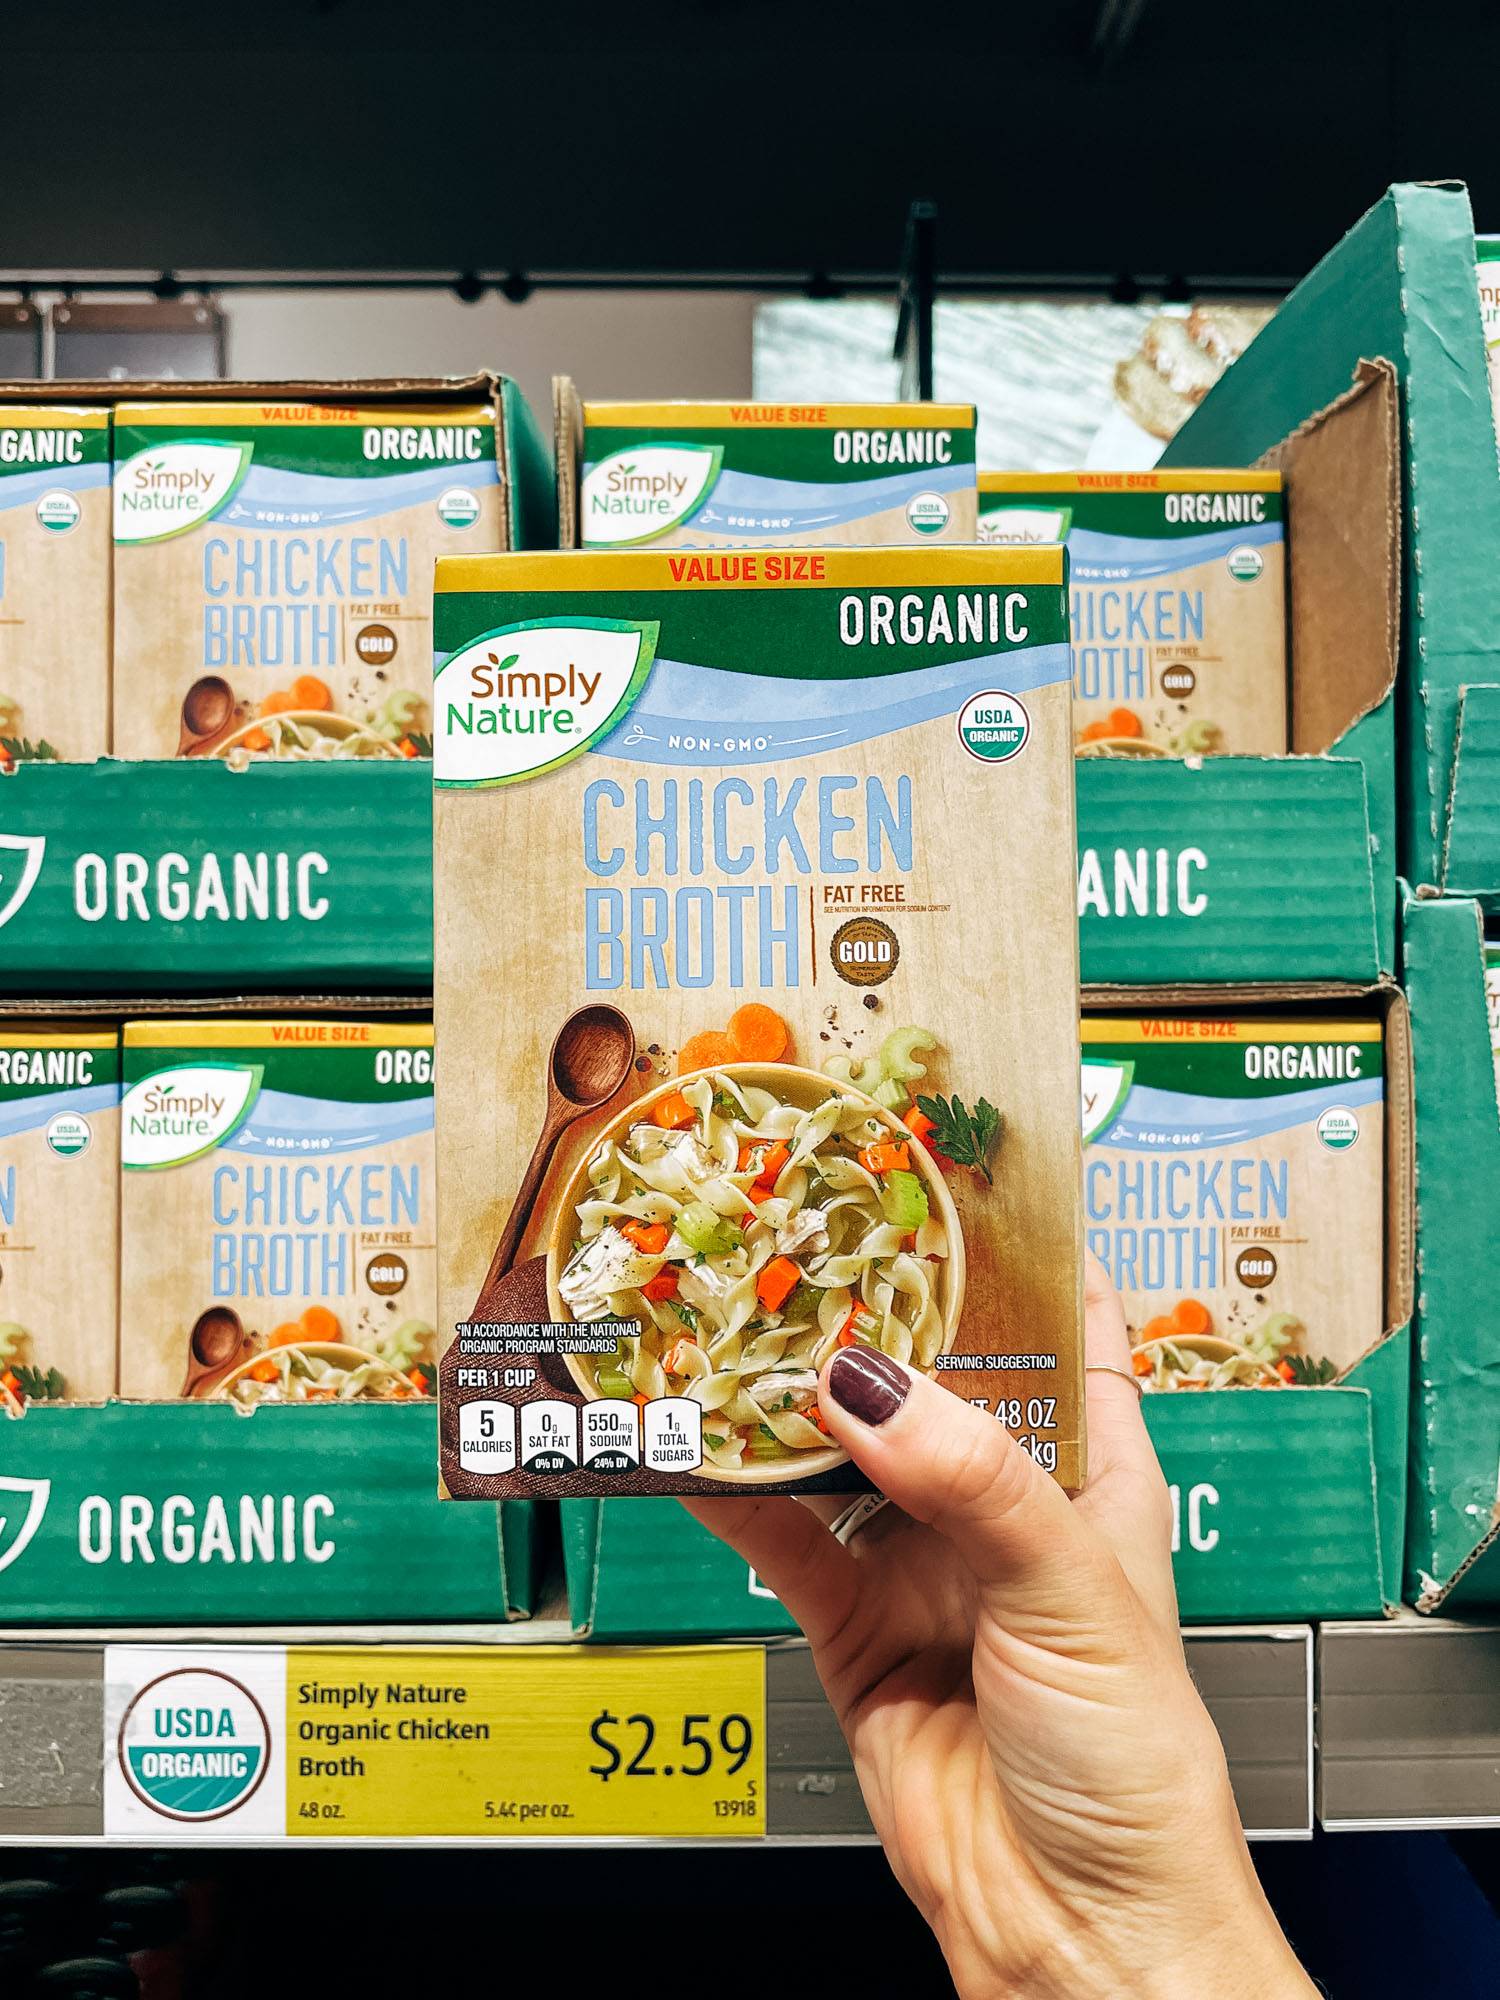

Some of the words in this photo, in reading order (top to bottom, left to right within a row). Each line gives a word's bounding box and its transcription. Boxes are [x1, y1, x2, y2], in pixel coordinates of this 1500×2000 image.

[261, 407, 315, 420] VALUE
[319, 408, 359, 421] SIZE
[730, 408, 785, 422] VALUE
[789, 408, 827, 422] SIZE
[363, 427, 482, 460] ORGANIC
[833, 431, 952, 464] ORGANIC
[135, 467, 215, 493] Simply
[607, 470, 688, 497] Simply
[1077, 475, 1123, 487] VALUE
[1127, 475, 1158, 487] SIZE
[122, 491, 199, 512] Nature
[592, 494, 670, 515] Nature
[1165, 494, 1265, 523] ORGANIC
[204, 538, 408, 597] CHICKEN
[669, 557, 758, 583] VALUE
[764, 556, 826, 581] SIZE
[350, 604, 369, 616] FAT
[373, 604, 401, 615] FREE
[840, 593, 1029, 646] ORGANIC
[204, 604, 337, 666] BROTH
[358, 636, 395, 653] GOLD
[471, 663, 602, 706] Simply
[447, 703, 574, 735] Nature
[974, 710, 1013, 725] USDA
[969, 730, 1019, 744] ORGANIC
[584, 775, 914, 877] CHICKEN
[73, 852, 330, 922] ORGANIC
[824, 885, 855, 903] FAT
[861, 885, 905, 902] FREE
[585, 886, 799, 991] BROTH
[839, 941, 891, 963] GOLD
[272, 1027, 327, 1041] VALUE
[332, 1027, 369, 1041] SIZE
[1139, 1022, 1195, 1037] VALUE
[1200, 1022, 1237, 1037] SIZE
[375, 1050, 434, 1084] ORG
[1245, 1046, 1362, 1079] ORGANIC
[144, 1093, 225, 1118] Simply
[130, 1116, 209, 1136] Nature
[213, 1165, 420, 1225] CHICKEN
[1087, 1160, 1288, 1220] CHICKEN
[361, 1232, 380, 1243] FAT
[384, 1232, 412, 1243] FREE
[1231, 1227, 1249, 1238] FAT
[1253, 1227, 1281, 1238] FREE
[213, 1233, 346, 1296] BROTH
[1088, 1227, 1216, 1291] BROTH
[1240, 1260, 1275, 1276] GOLD
[369, 1266, 404, 1283] GOLD
[473, 1324, 540, 1338] ACCORDANCE
[541, 1324, 565, 1337] WITH
[568, 1324, 588, 1337] THE
[590, 1323, 640, 1337] NATIONAL
[460, 1340, 504, 1354] ORGANIC
[505, 1340, 555, 1353] PROGRAM
[556, 1340, 617, 1353] STANDARDS
[936, 1355, 983, 1370] SERVING
[985, 1355, 1056, 1369] SUGGESTION
[458, 1369, 488, 1387] PER
[490, 1370, 499, 1387] 1
[504, 1369, 536, 1387] CUP
[479, 1409, 495, 1437] 5
[994, 1399, 1022, 1429] 48
[1027, 1398, 1058, 1429] OZ
[463, 1440, 512, 1453] CALORIES
[528, 1435, 549, 1448] SAT
[551, 1435, 571, 1447] FAT
[590, 1434, 632, 1447] SODIUM
[657, 1433, 689, 1446] TOTAL
[535, 1456, 551, 1469] 0%
[552, 1456, 565, 1469] DV
[594, 1456, 614, 1469] 24%
[615, 1456, 629, 1469] DV
[652, 1449, 694, 1462] SUGARS
[78, 1493, 336, 1564] ORGANIC
[299, 1682, 379, 1709] Simply
[386, 1684, 467, 1704] Nature
[154, 1708, 236, 1738] USDA
[299, 1718, 391, 1745] Organic
[397, 1718, 490, 1740] Chicken
[589, 1709, 753, 1782] $2.59
[141, 1752, 248, 1779] ORGANIC
[299, 1755, 365, 1777] Broth
[746, 1780, 757, 1797] S
[299, 1801, 319, 1818] 48
[322, 1803, 345, 1818] oz.
[519, 1803, 547, 1822] per
[550, 1803, 575, 1818] oz.
[713, 1800, 757, 1817] 13918
